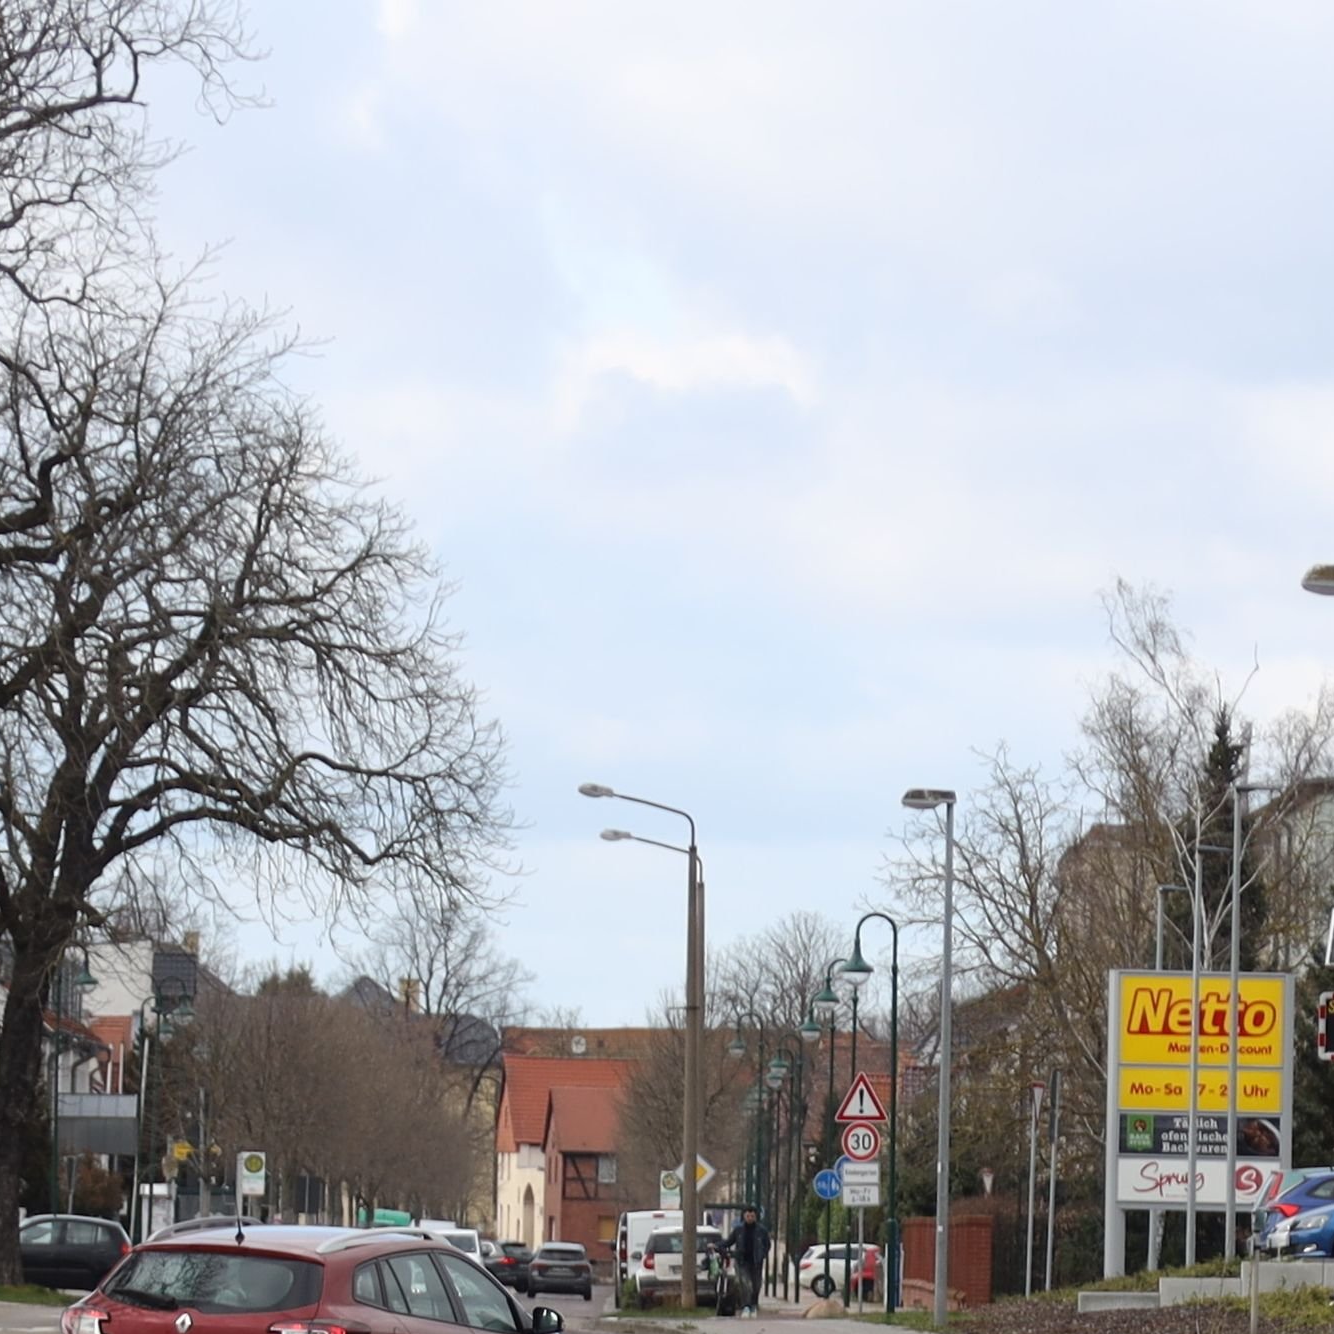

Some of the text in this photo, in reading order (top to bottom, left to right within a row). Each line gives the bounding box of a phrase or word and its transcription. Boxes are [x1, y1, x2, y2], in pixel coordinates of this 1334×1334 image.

[1127, 988, 1276, 1037] Netto
[1243, 1085, 1270, 1098] Uhr
[1173, 1117, 1218, 1129] Tälich
[851, 1133, 872, 1150] 30
